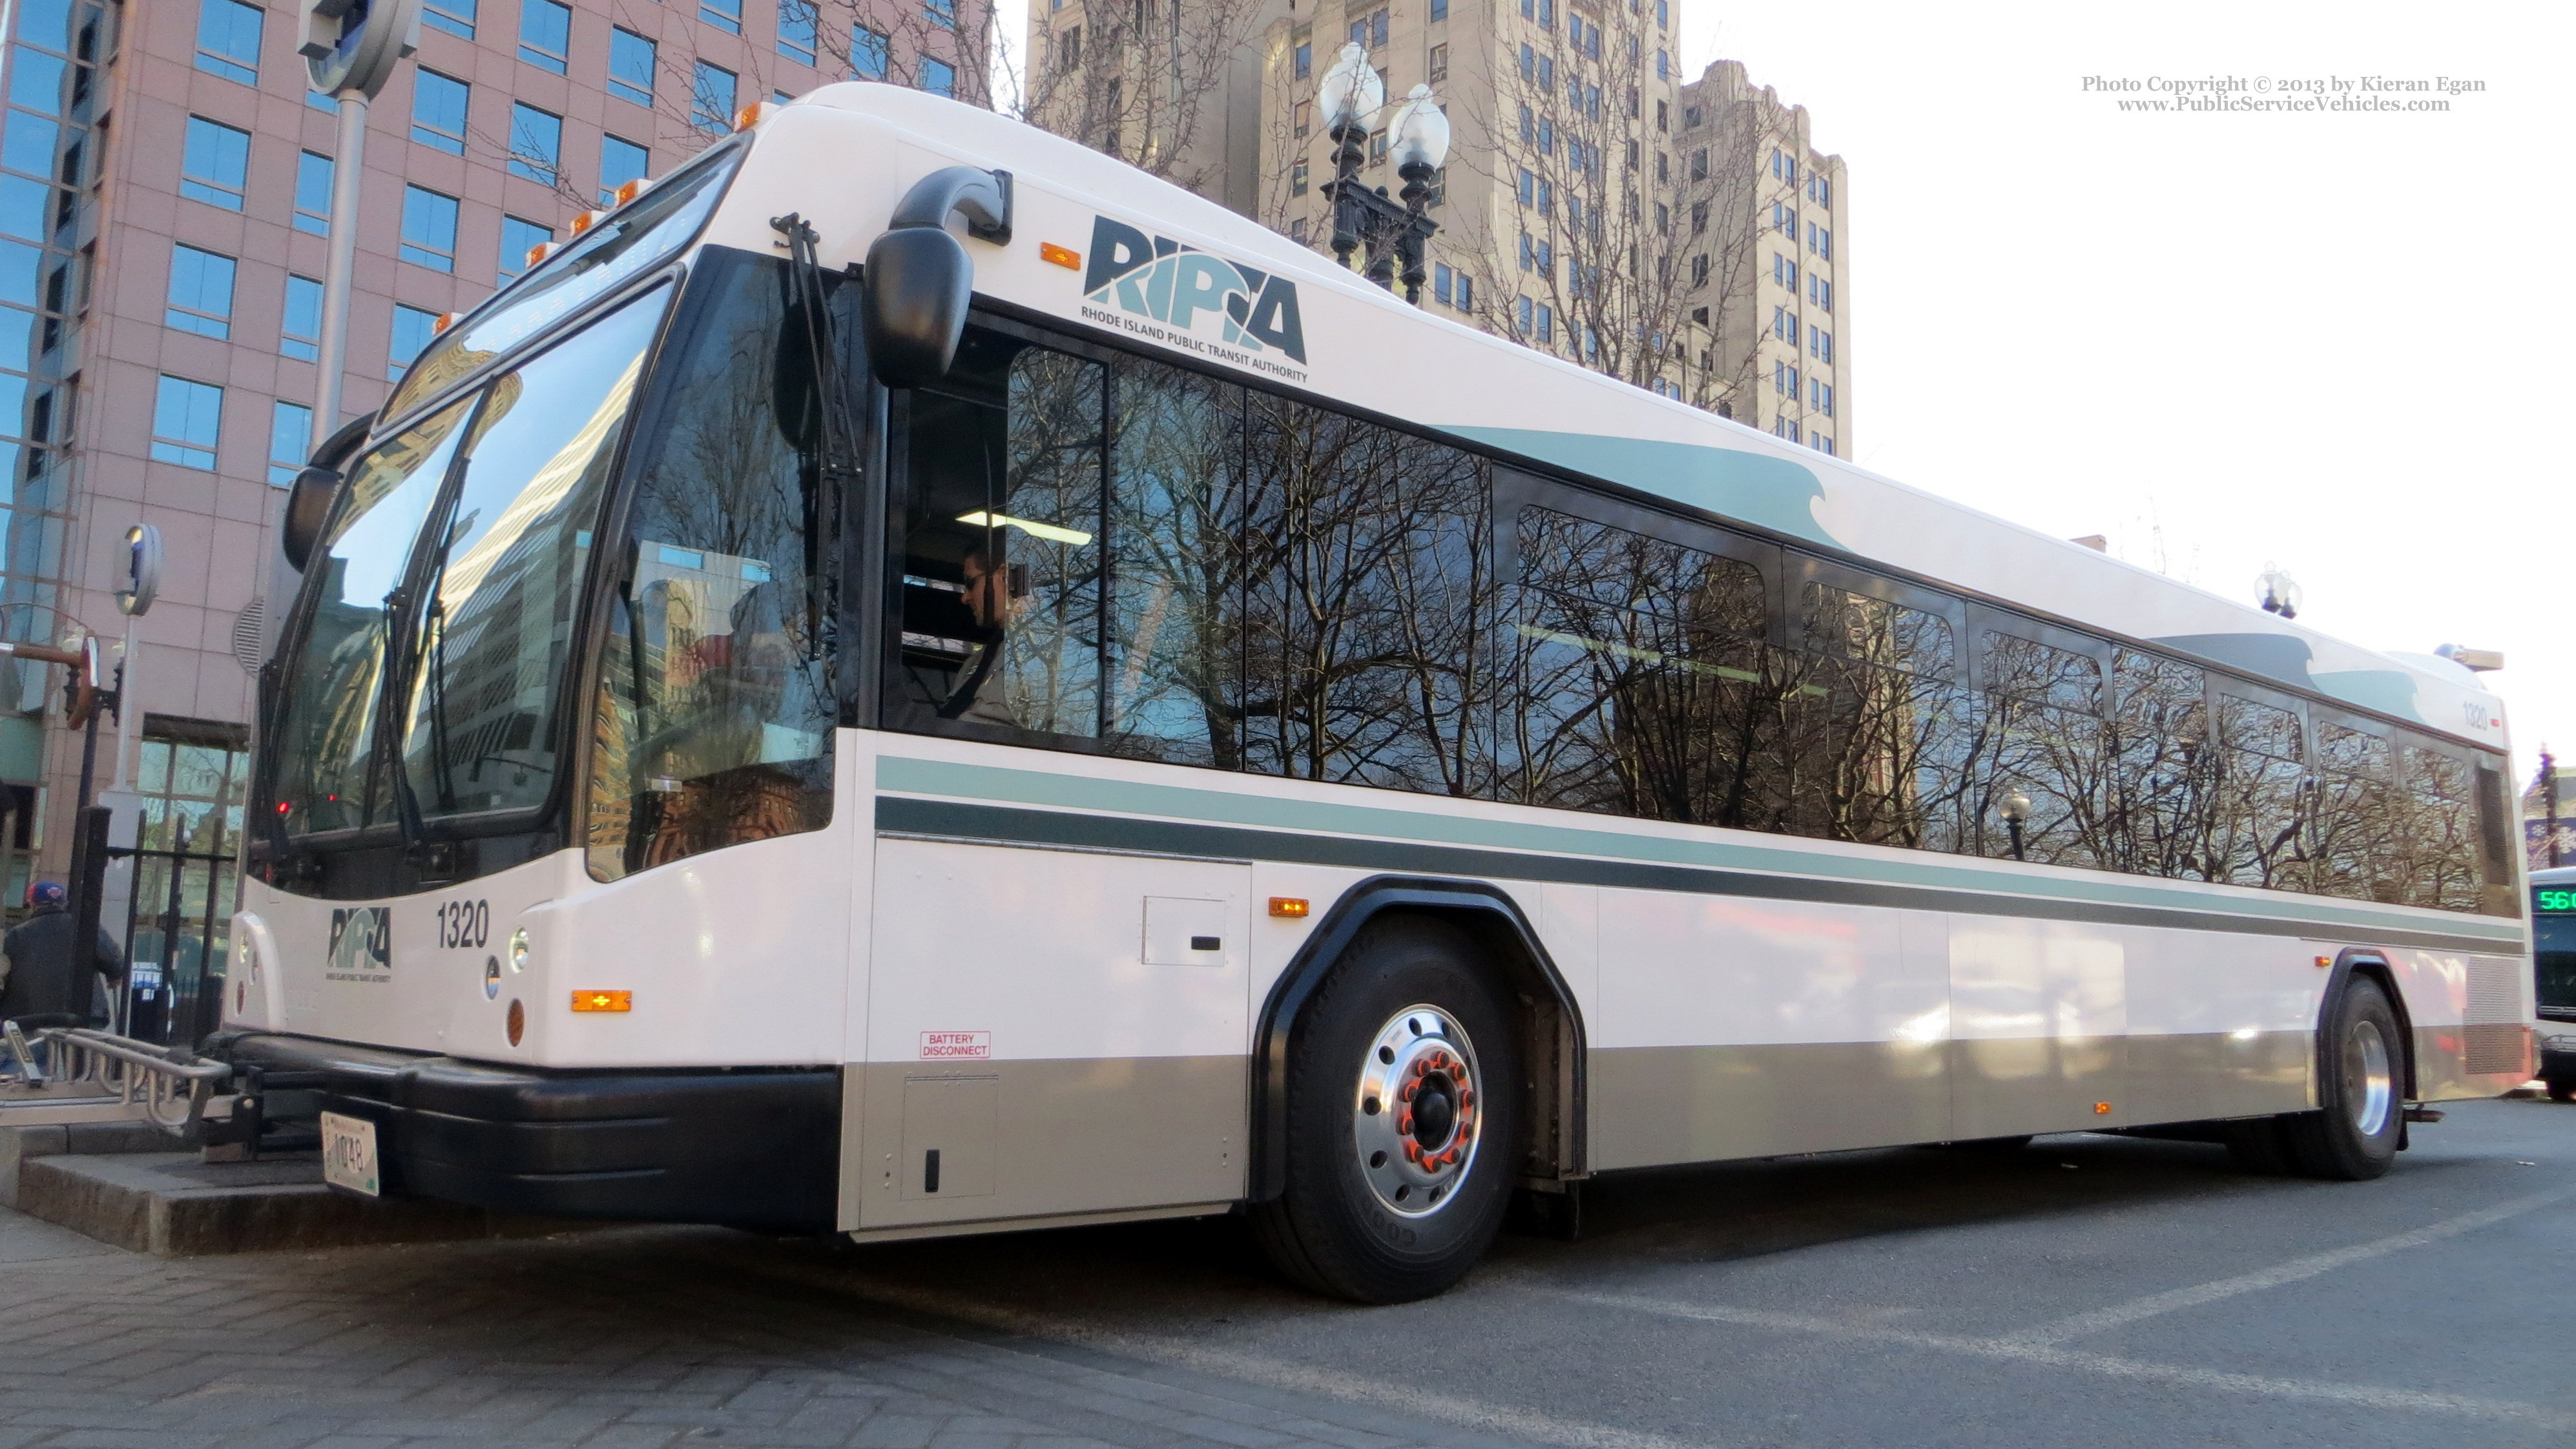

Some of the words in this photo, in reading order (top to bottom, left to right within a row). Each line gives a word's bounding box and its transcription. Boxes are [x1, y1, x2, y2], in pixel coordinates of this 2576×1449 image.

[1083, 214, 1307, 366] RIPTA
[1081, 305, 1121, 328] RHODE
[1123, 318, 1165, 340] ISLAND
[1168, 331, 1205, 353] PUBLIC
[1207, 343, 1251, 366] TRANSIT
[1251, 358, 1308, 384] AUTHORITY
[2462, 701, 2488, 731] 1320
[327, 906, 391, 969] RIPTA
[437, 899, 489, 949] 1320
[923, 1046, 988, 1056] DISCONNECT
[929, 1034, 974, 1044] BATTERY
